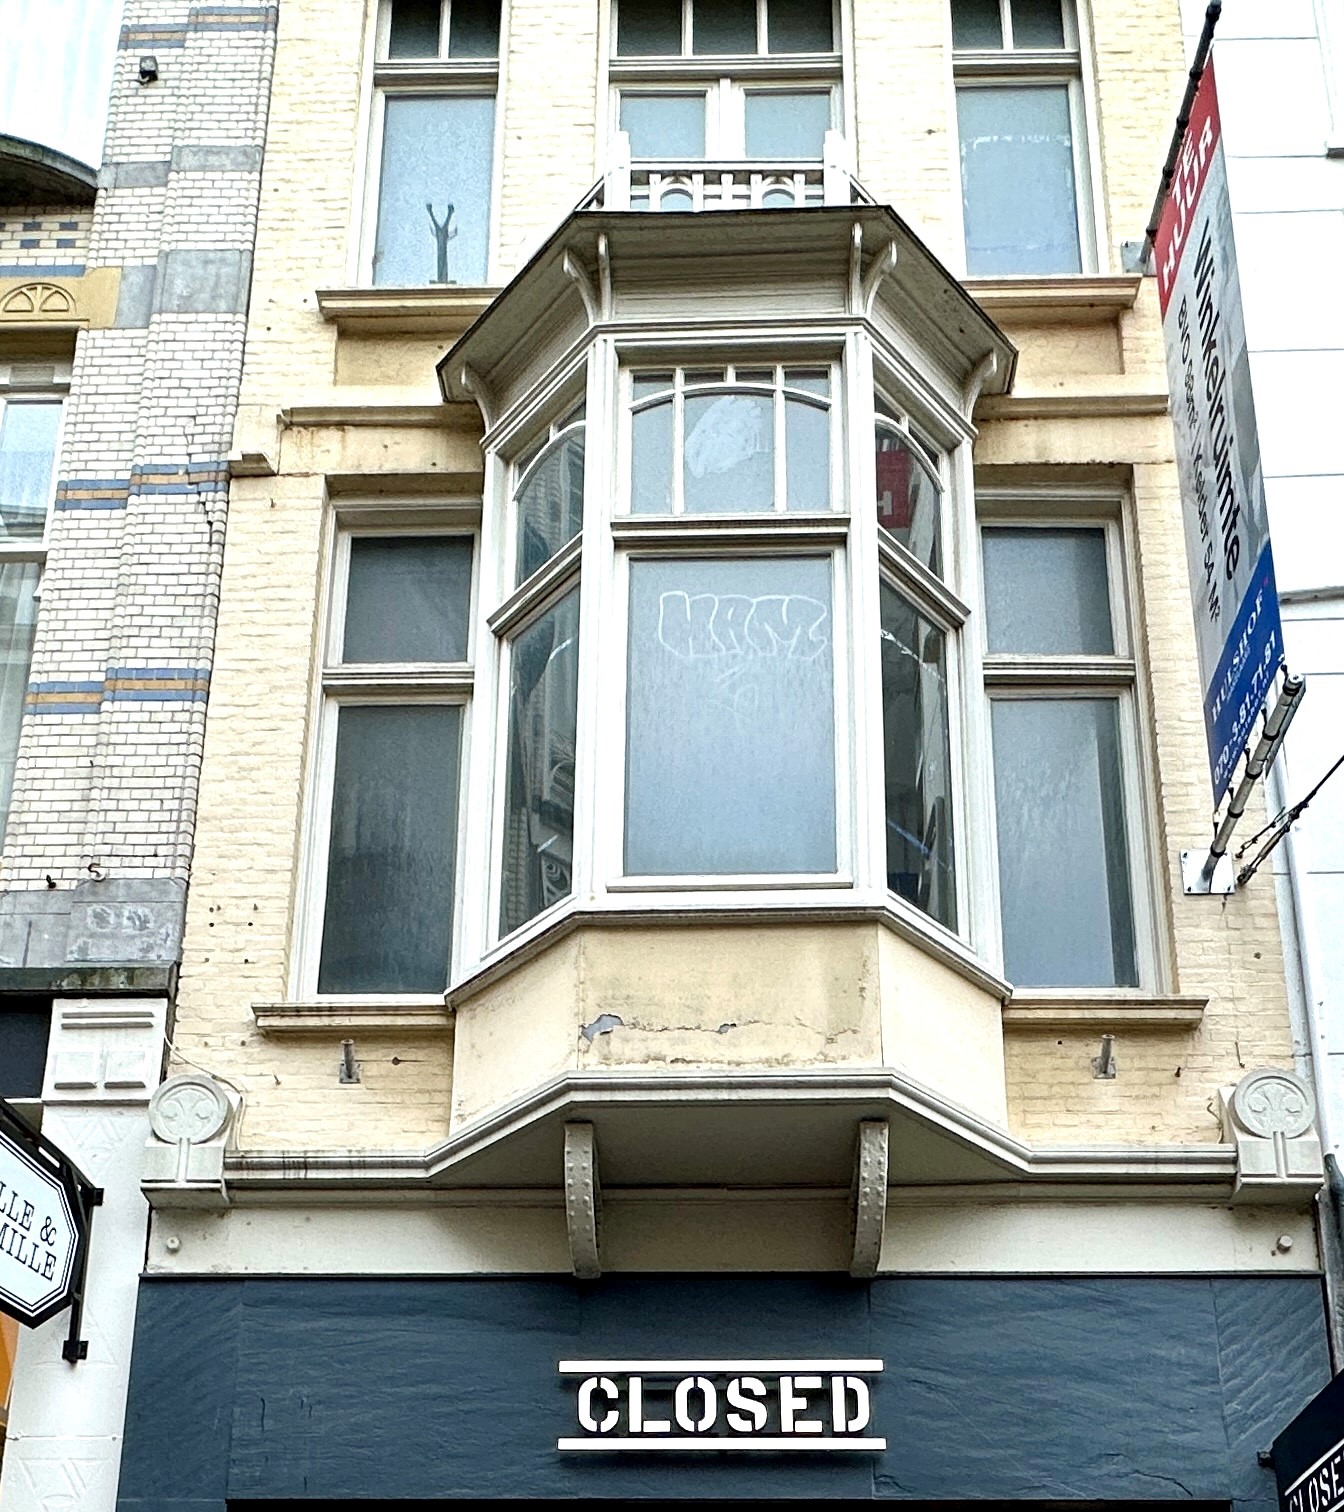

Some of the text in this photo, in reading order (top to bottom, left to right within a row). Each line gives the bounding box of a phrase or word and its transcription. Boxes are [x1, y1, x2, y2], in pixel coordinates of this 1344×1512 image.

[1162, 115, 1213, 293] HUUR
[1172, 129, 1194, 207] TE
[1178, 294, 1191, 365] BVO
[1193, 441, 1209, 543] Kelder
[1204, 540, 1214, 588] 54
[1194, 217, 1241, 581] Winkelruimte
[1212, 588, 1263, 724] HULSHOF
[40, 1216, 57, 1247] &
[578, 1376, 870, 1433] CLOSED
